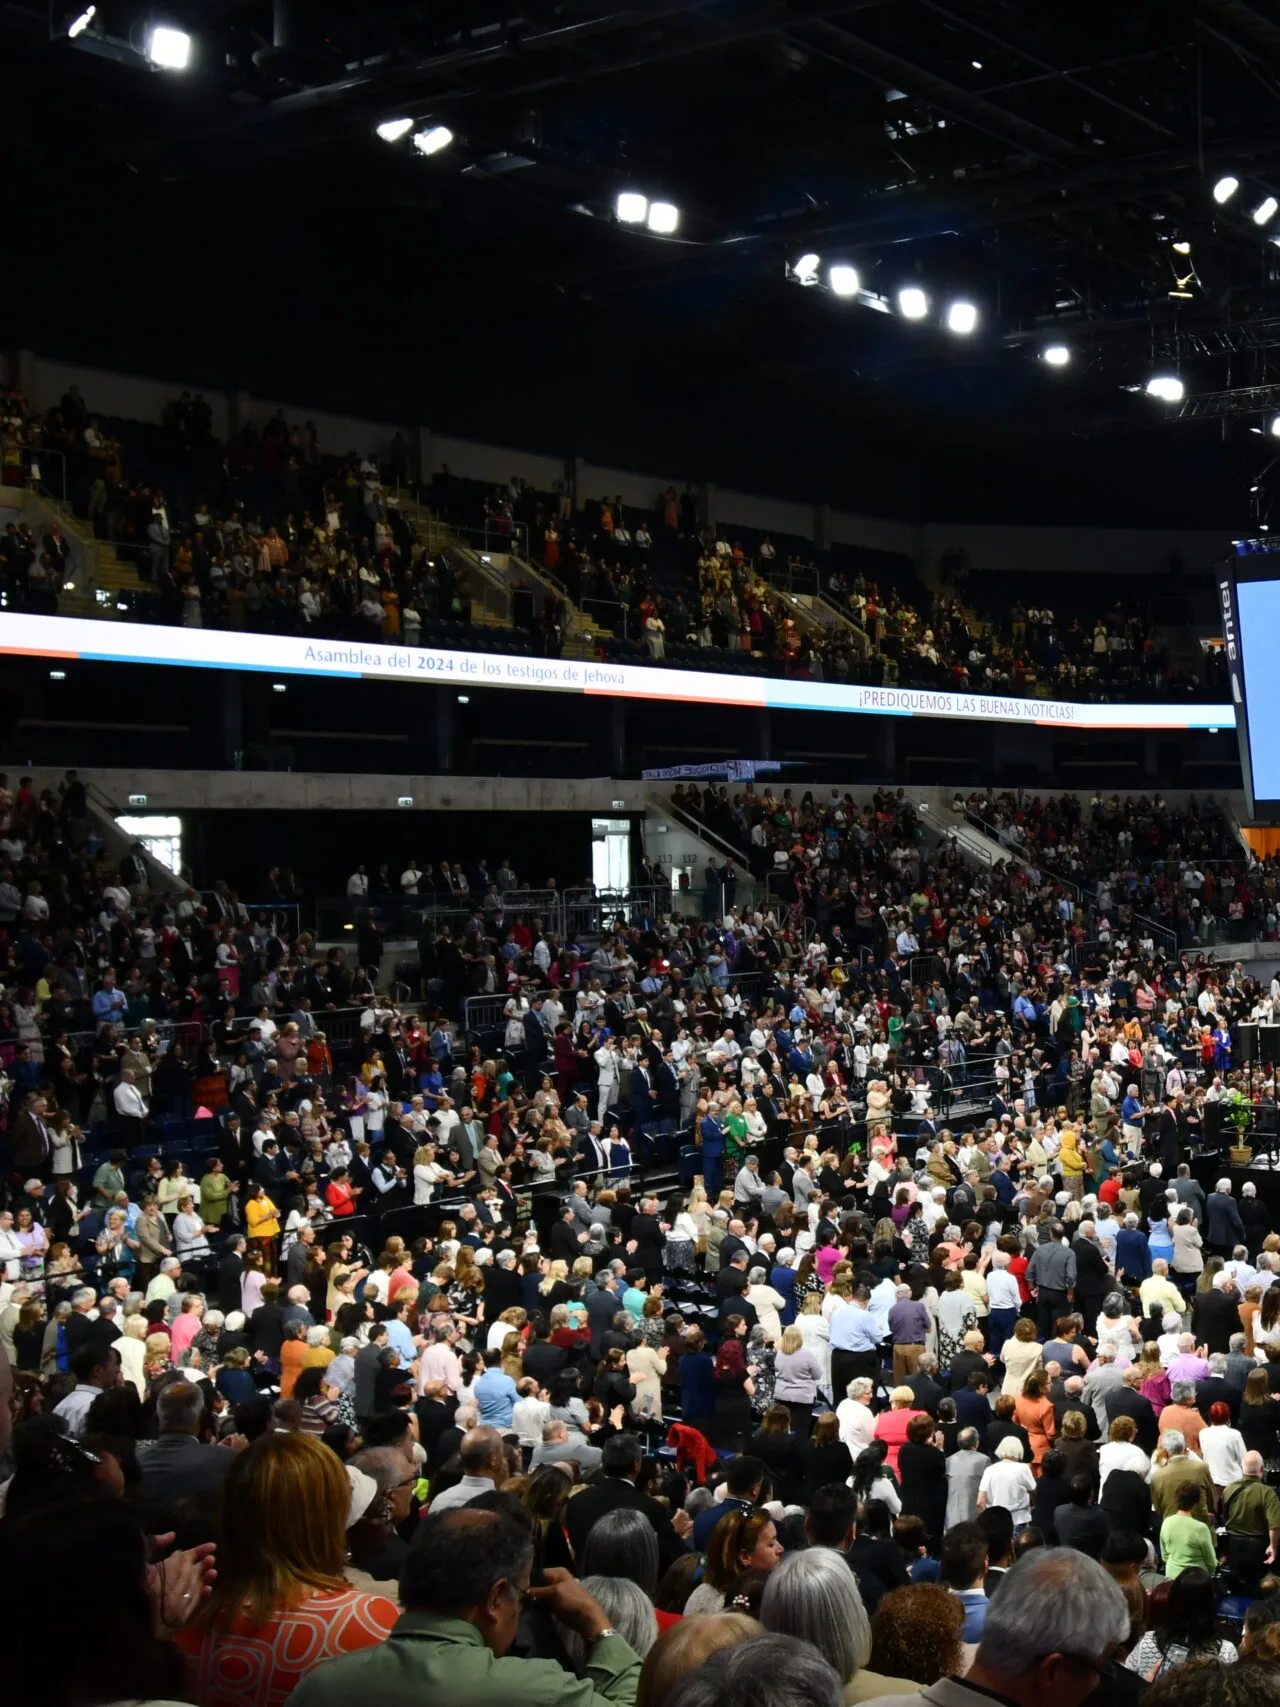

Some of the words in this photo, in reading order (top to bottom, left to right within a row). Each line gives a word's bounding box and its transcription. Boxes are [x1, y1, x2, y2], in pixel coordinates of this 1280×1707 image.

[1219, 581, 1237, 660] antel
[304, 645, 382, 667] Asamblea
[388, 653, 411, 669] del
[417, 657, 455, 672] 2024
[460, 659, 478, 674] de
[483, 661, 502, 676] los
[507, 663, 558, 683] testigos
[563, 667, 579, 682] de
[583, 669, 625, 685] Jehová
[859, 690, 952, 711] ¡PREDIQUEMOS
[956, 698, 976, 713] LAS
[980, 700, 1021, 716] BUENAS
[1024, 703, 1075, 720] NOTICIAS!
